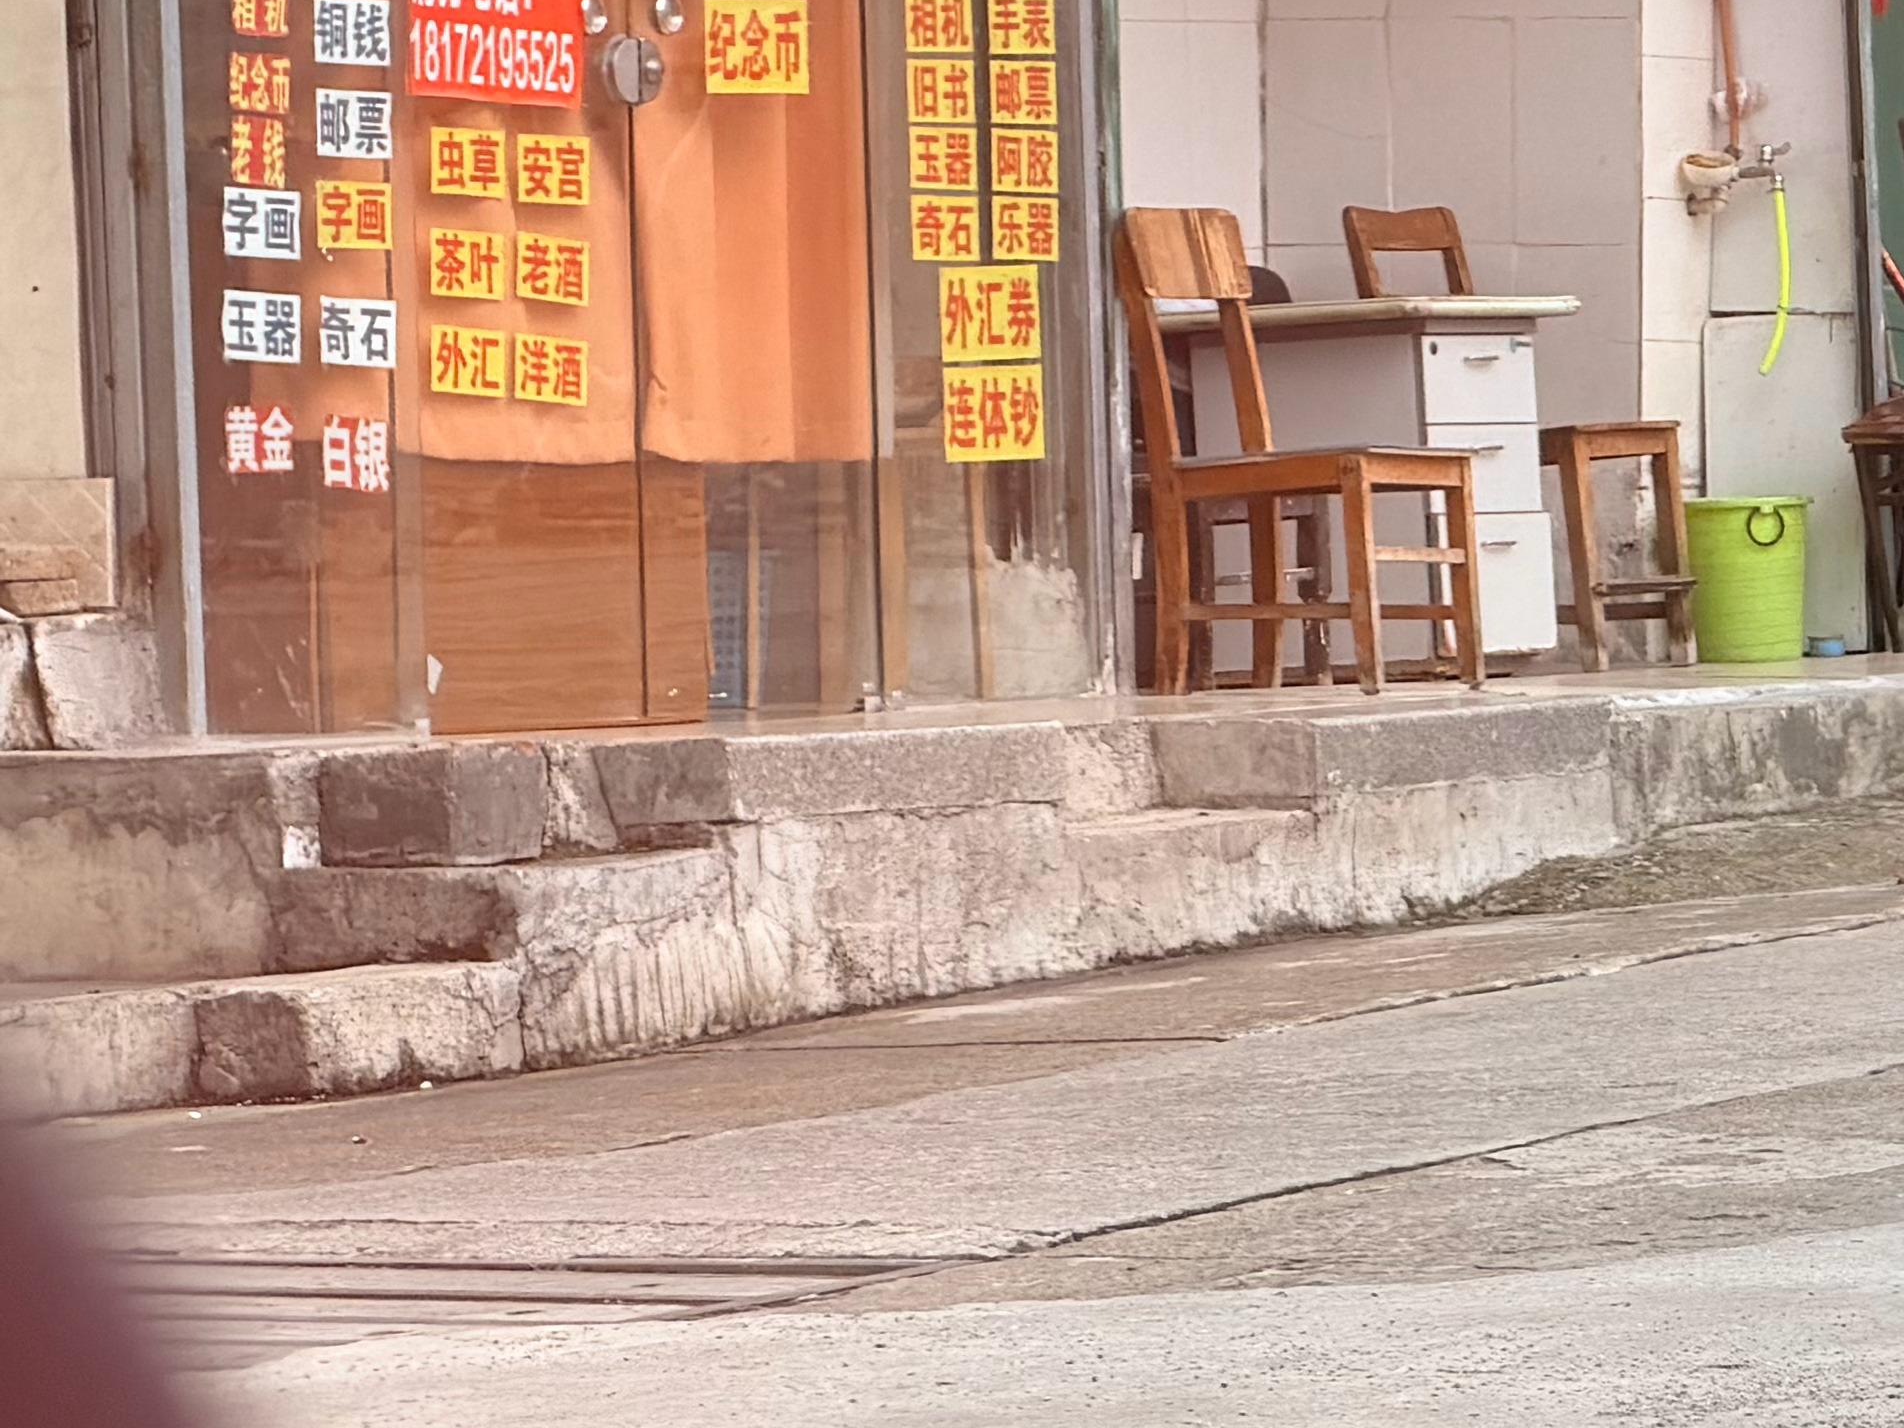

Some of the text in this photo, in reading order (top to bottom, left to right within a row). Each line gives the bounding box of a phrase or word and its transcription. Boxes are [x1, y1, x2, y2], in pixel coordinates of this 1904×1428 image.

[315, 2, 388, 62] 铜钱
[409, 28, 574, 93] 18172195525
[706, 9, 803, 84] 纪念币
[229, 53, 290, 115] 纪念币
[913, 66, 971, 121] 旧书
[995, 69, 1053, 120] 邮票
[231, 117, 286, 187] 老钱
[318, 97, 390, 154] 邮票
[437, 133, 500, 191] 虫草
[523, 142, 586, 201] 安宫
[915, 132, 972, 186] 玉器
[999, 132, 1053, 188] 阿胶
[225, 191, 298, 254] 字画
[320, 184, 387, 245] 字画
[915, 203, 974, 256] 奇石
[999, 203, 1054, 258] 乐器
[435, 233, 499, 295] 茶叶
[522, 239, 584, 302] 老酒
[226, 292, 298, 357] 玉器
[322, 302, 392, 363] 奇石
[944, 278, 1035, 350] 外汇券
[435, 332, 499, 391] 外汇
[519, 340, 583, 402] 洋酒
[225, 407, 294, 471] 黄金
[947, 377, 1039, 450] 连体钞
[323, 417, 390, 492] 白银
